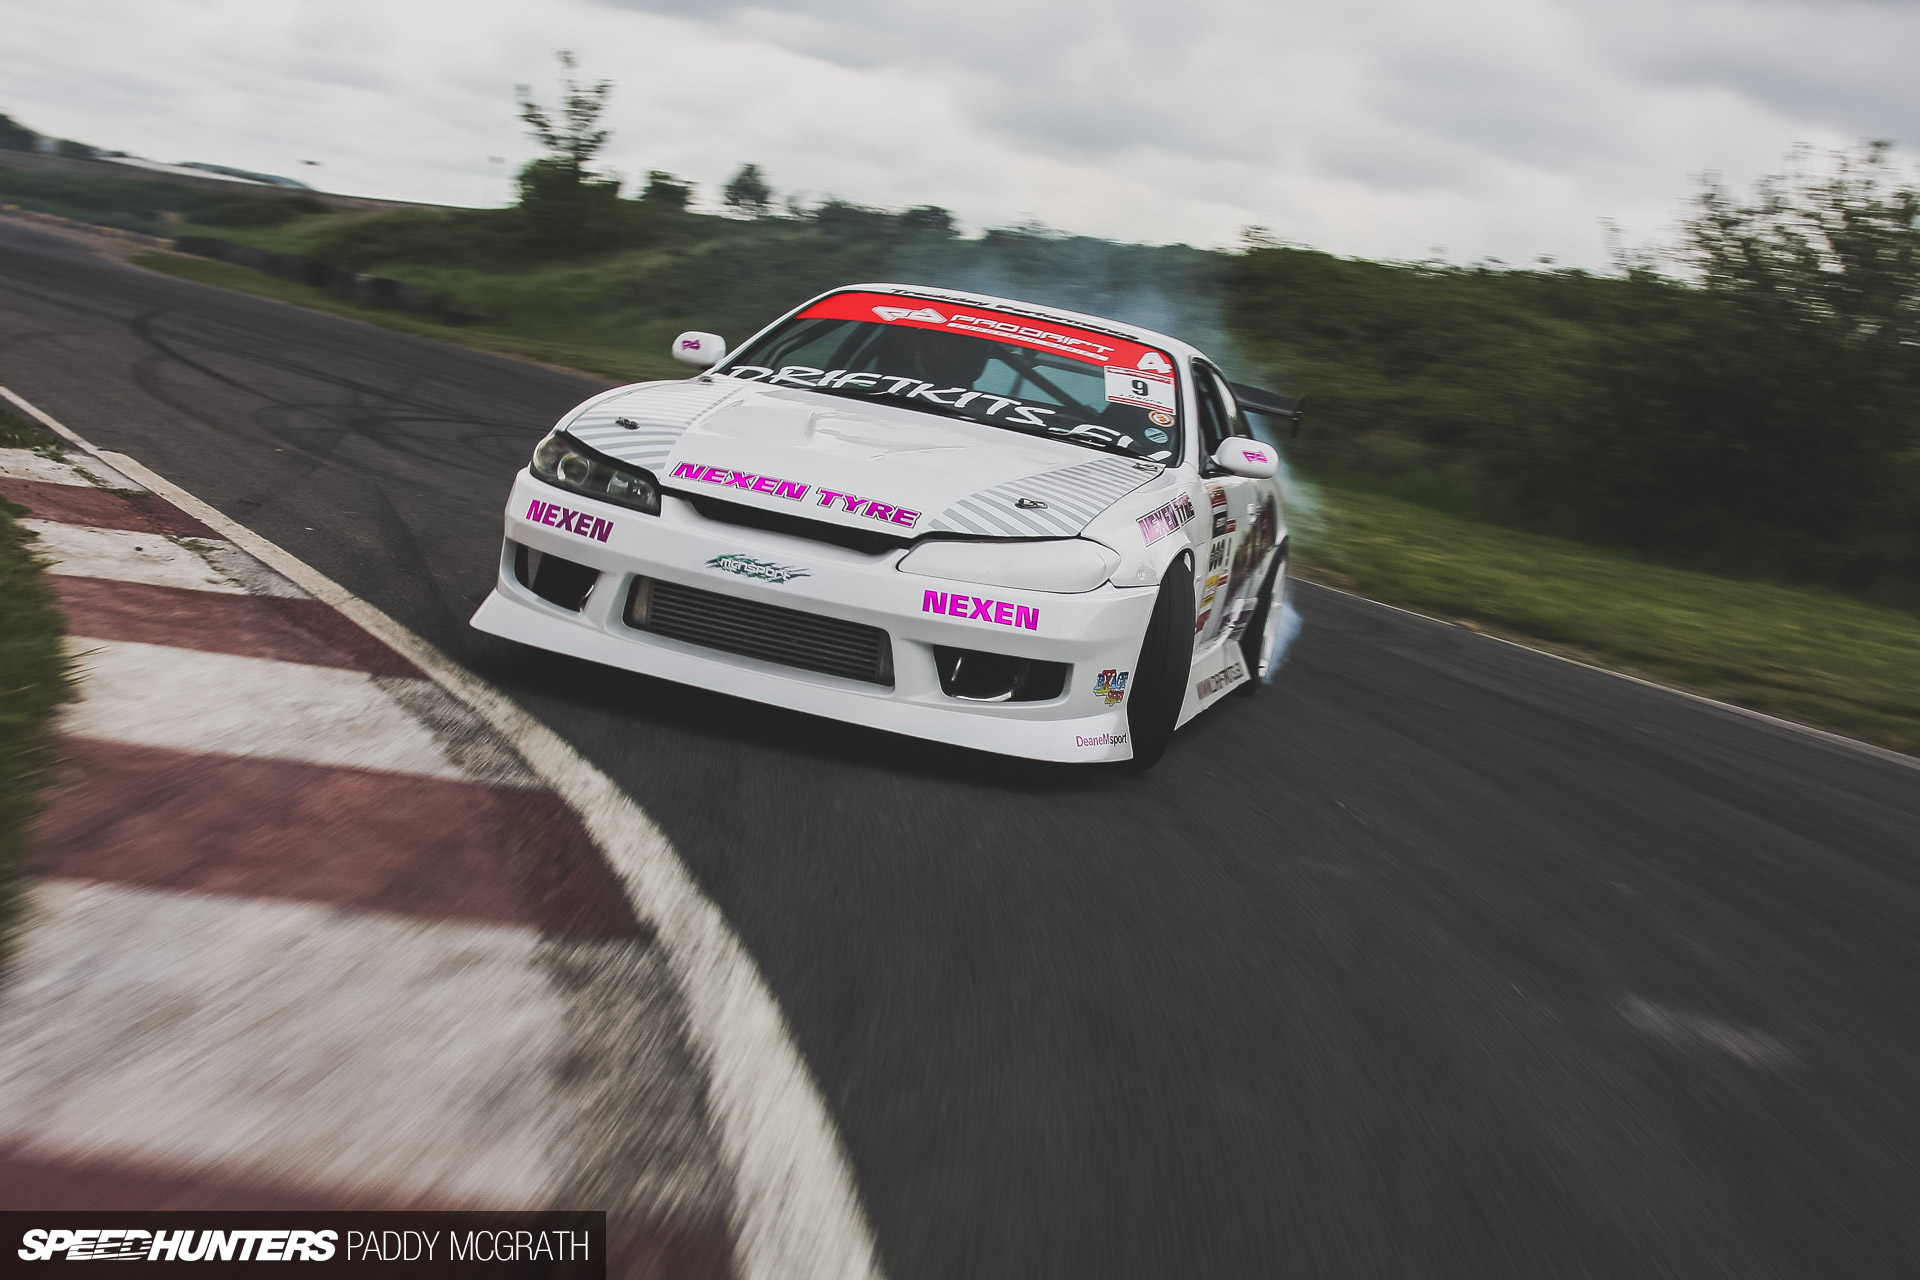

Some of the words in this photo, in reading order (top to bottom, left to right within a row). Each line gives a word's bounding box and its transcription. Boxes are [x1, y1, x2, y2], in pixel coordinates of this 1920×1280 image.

[949, 314, 1115, 354] PRODRIFT
[1131, 379, 1149, 397] 9
[669, 461, 811, 502] NEXEN
[816, 487, 922, 529] TYRE
[526, 499, 614, 543] NEXEN
[922, 590, 1039, 631] NEXEN
[1075, 733, 1128, 748] DeaneMsport
